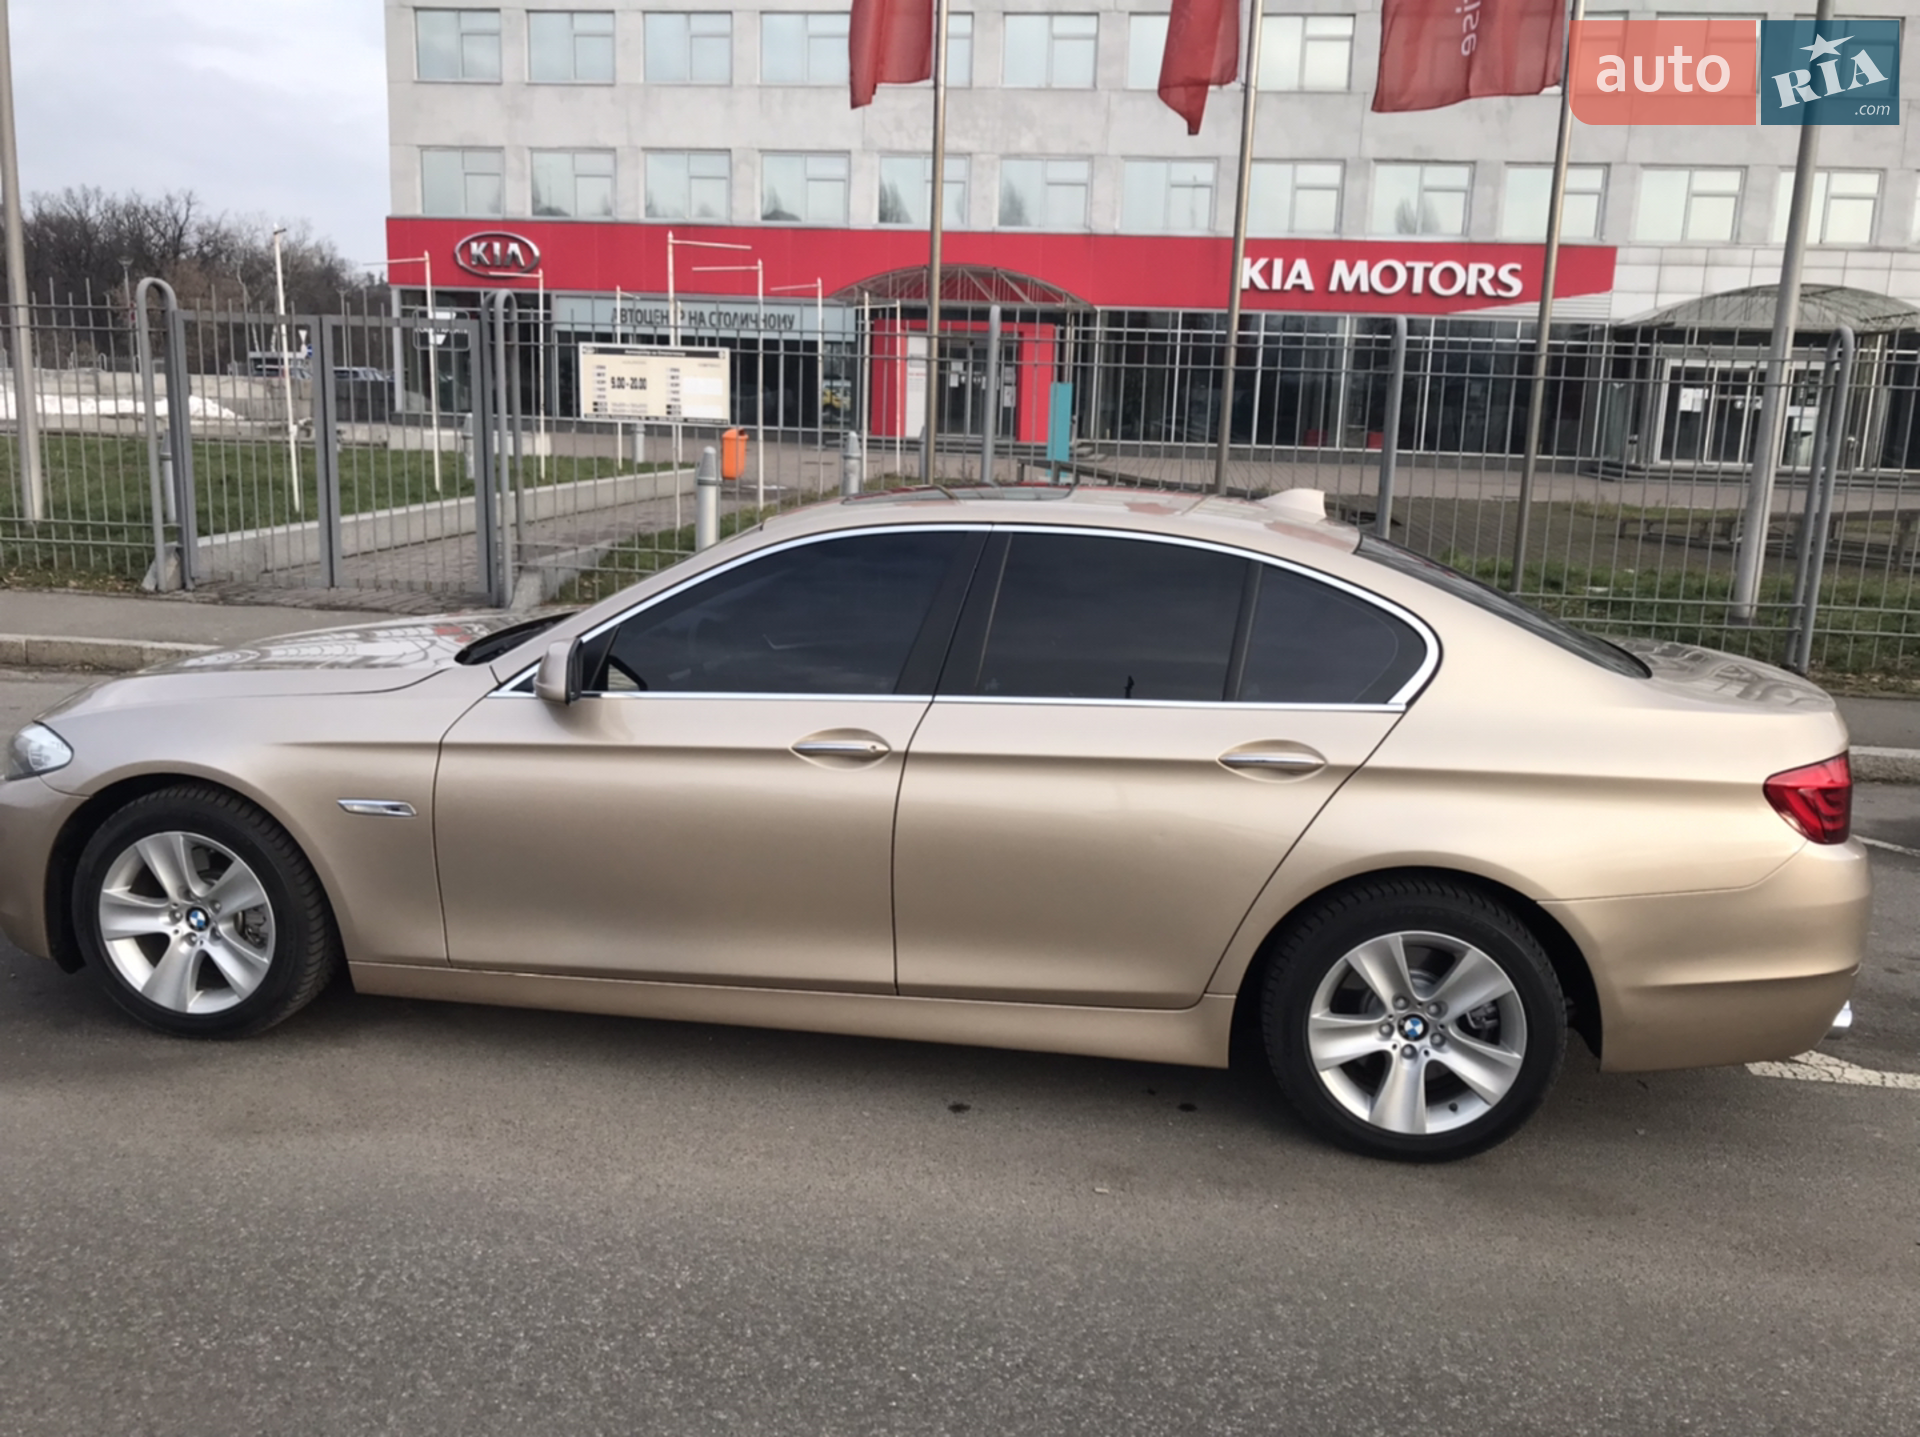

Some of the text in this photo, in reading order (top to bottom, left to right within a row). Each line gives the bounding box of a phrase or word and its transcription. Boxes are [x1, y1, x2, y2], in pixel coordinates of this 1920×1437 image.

[469, 241, 526, 267] KIA
[1240, 257, 1524, 299] KIA MOTORS
[611, 307, 685, 326] АВТОЦЕНР
[688, 310, 706, 327] НА
